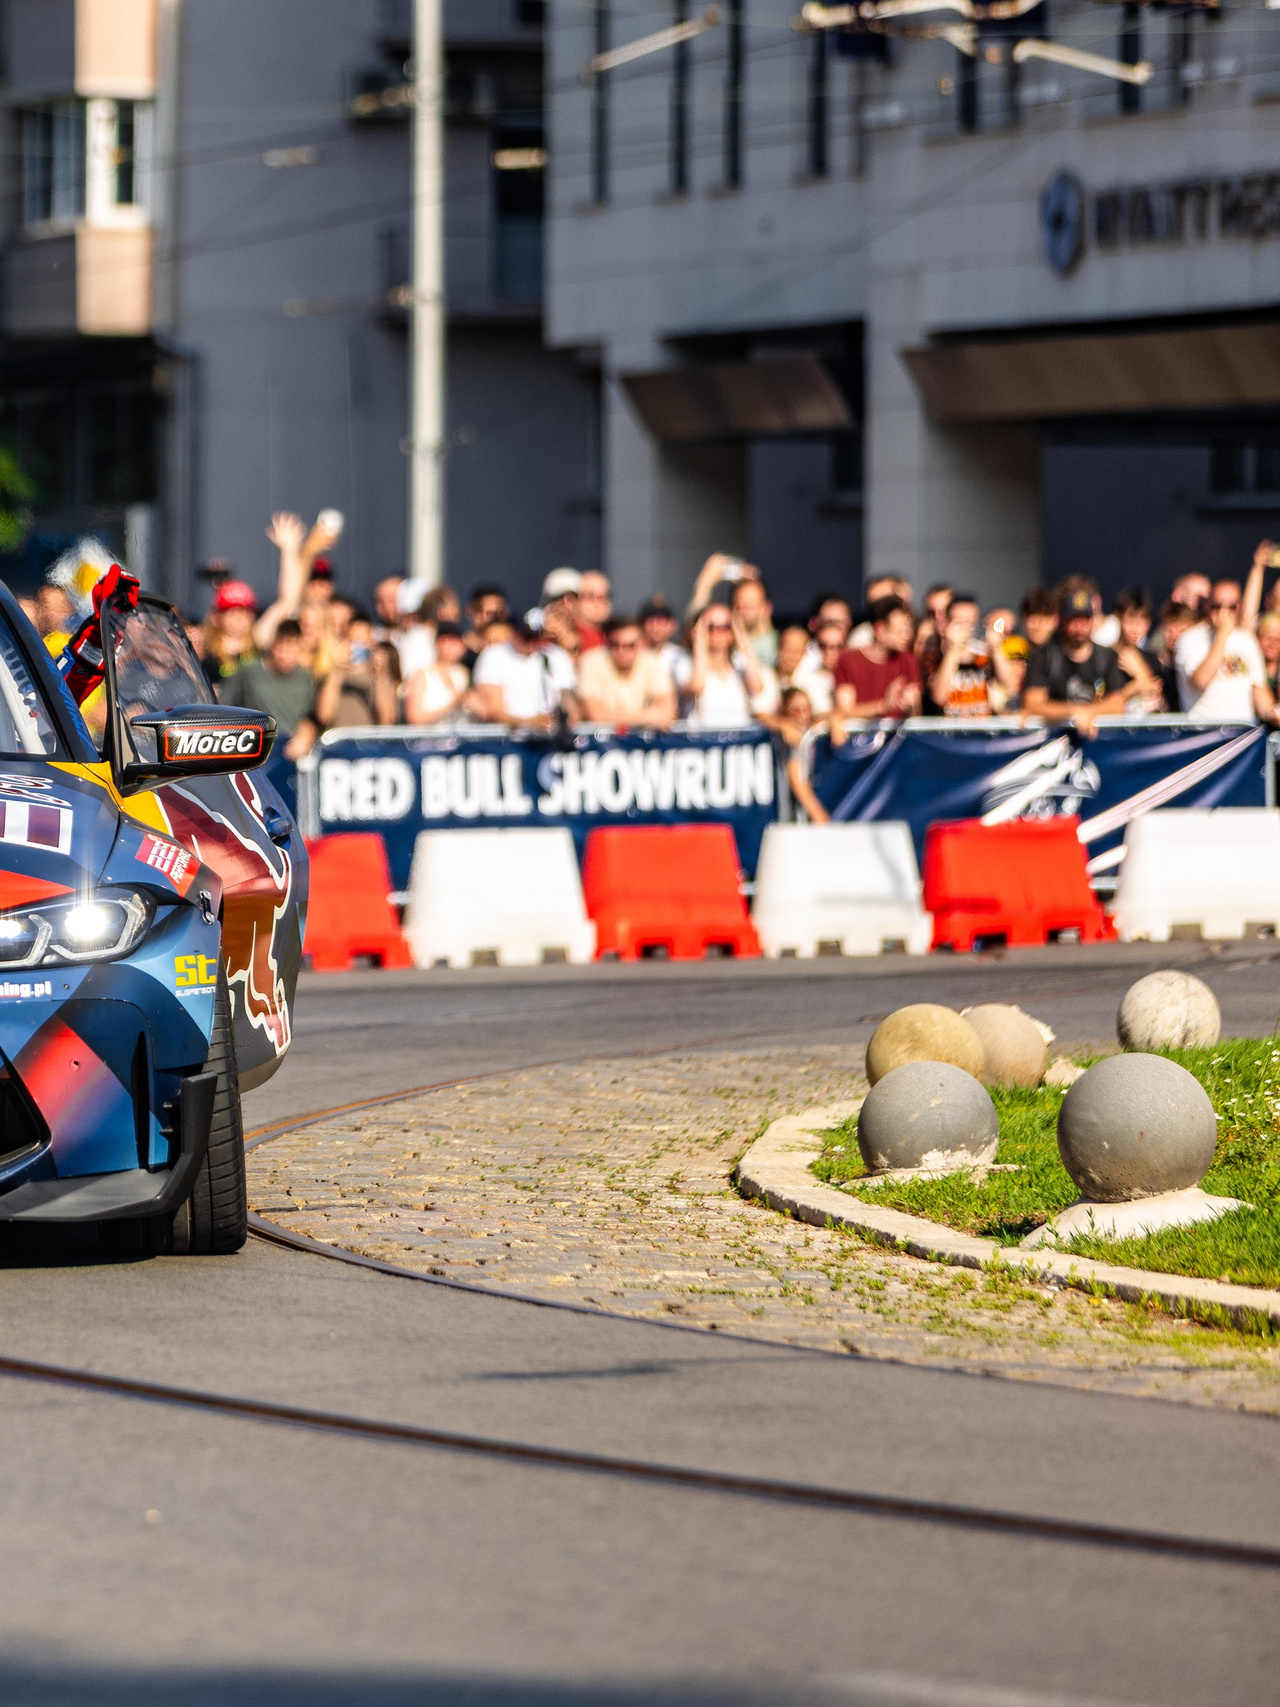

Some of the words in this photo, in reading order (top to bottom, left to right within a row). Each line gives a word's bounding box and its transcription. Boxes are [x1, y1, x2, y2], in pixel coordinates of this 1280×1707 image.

[175, 730, 255, 754] MoTeC
[320, 757, 414, 820] RED
[421, 753, 532, 818] BULL
[538, 743, 775, 816] SHOWRUN
